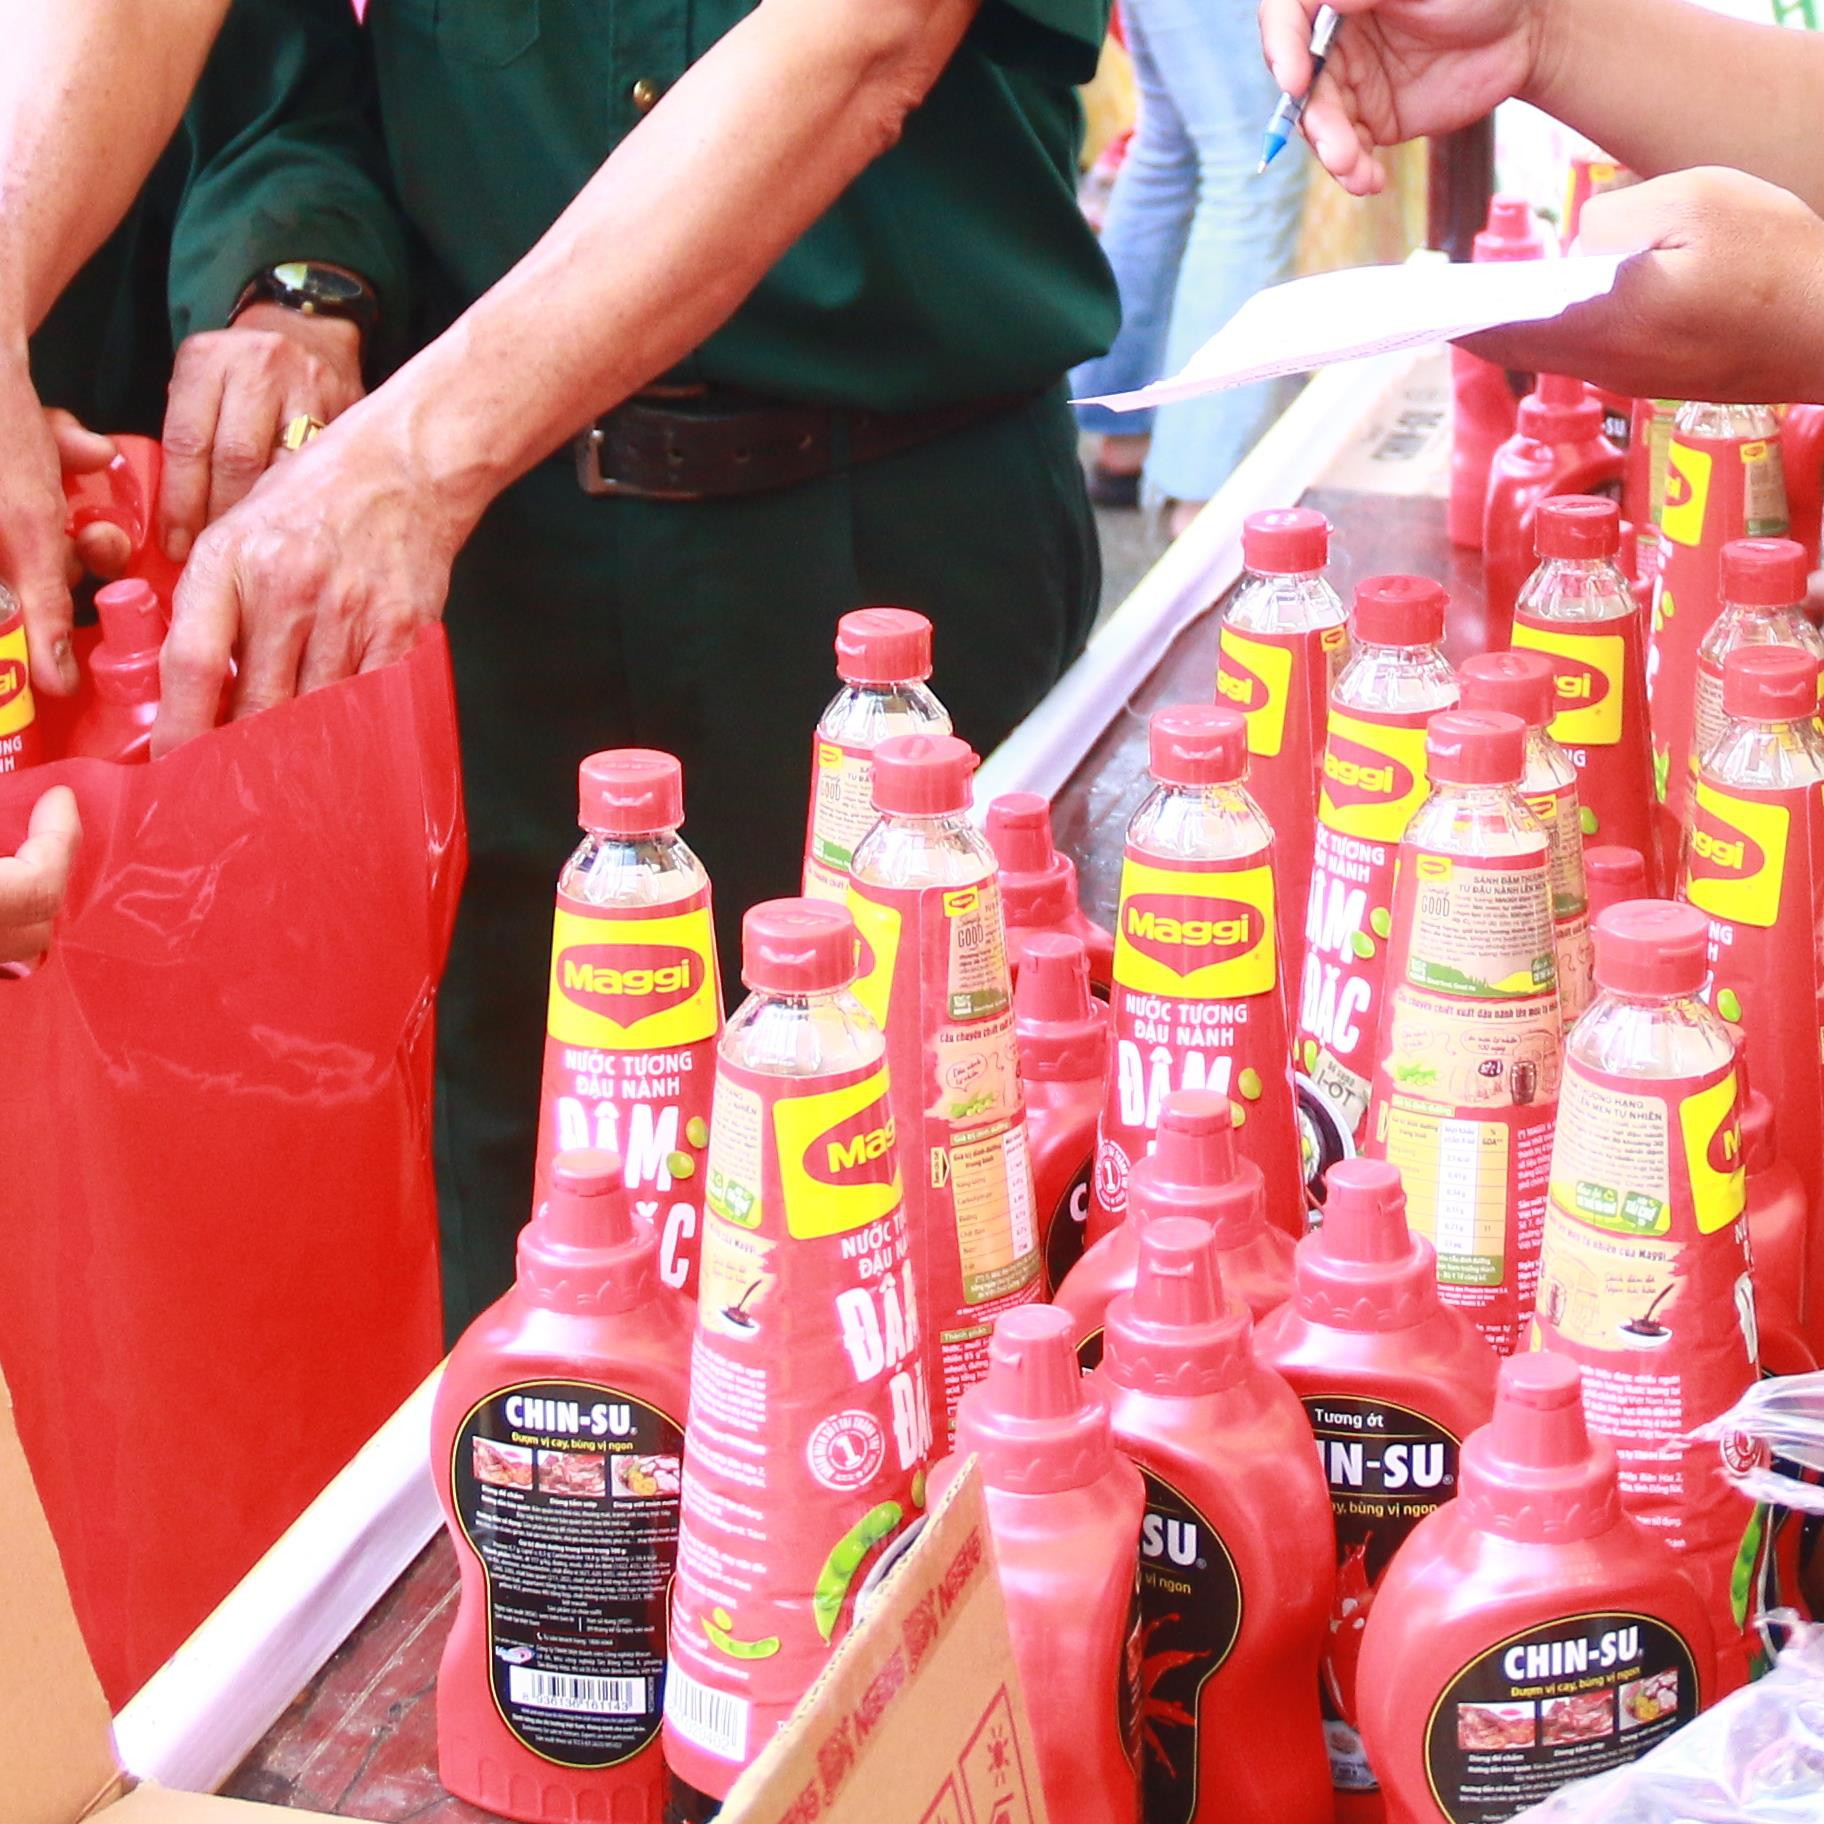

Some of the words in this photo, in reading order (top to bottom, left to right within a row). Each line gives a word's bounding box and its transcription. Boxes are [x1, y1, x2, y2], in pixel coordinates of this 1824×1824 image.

[1325, 756, 1395, 794] aggi
[1128, 907, 1250, 946] Maggi
[564, 959, 690, 996] Maggi
[1126, 993, 1171, 1020] NƯỚC
[1179, 1003, 1247, 1024] TƯƠNG
[1134, 1020, 1169, 1046] ĐẬU
[1177, 1026, 1234, 1048] NÀNH
[564, 1048, 616, 1075] NƯỚC
[622, 1049, 693, 1077] TƯƠNG
[576, 1072, 614, 1100] ĐẬU
[622, 1075, 680, 1099] NÀNH
[505, 1395, 631, 1436] CHIN-SU
[1315, 1408, 1363, 1428] Tương
[1367, 1412, 1384, 1428] ớt
[511, 1431, 538, 1446] Đượm
[608, 1441, 634, 1452] ngon
[836, 1436, 862, 1468] 1
[1315, 1440, 1444, 1488] N-SU
[1349, 1501, 1384, 1516] bùng
[1387, 1504, 1400, 1518] vị
[1403, 1504, 1438, 1515] ngon
[1159, 1577, 1192, 1594] ngon
[1504, 1625, 1639, 1681] CHIN-SU
[1511, 1685, 1543, 1697] Đượm
